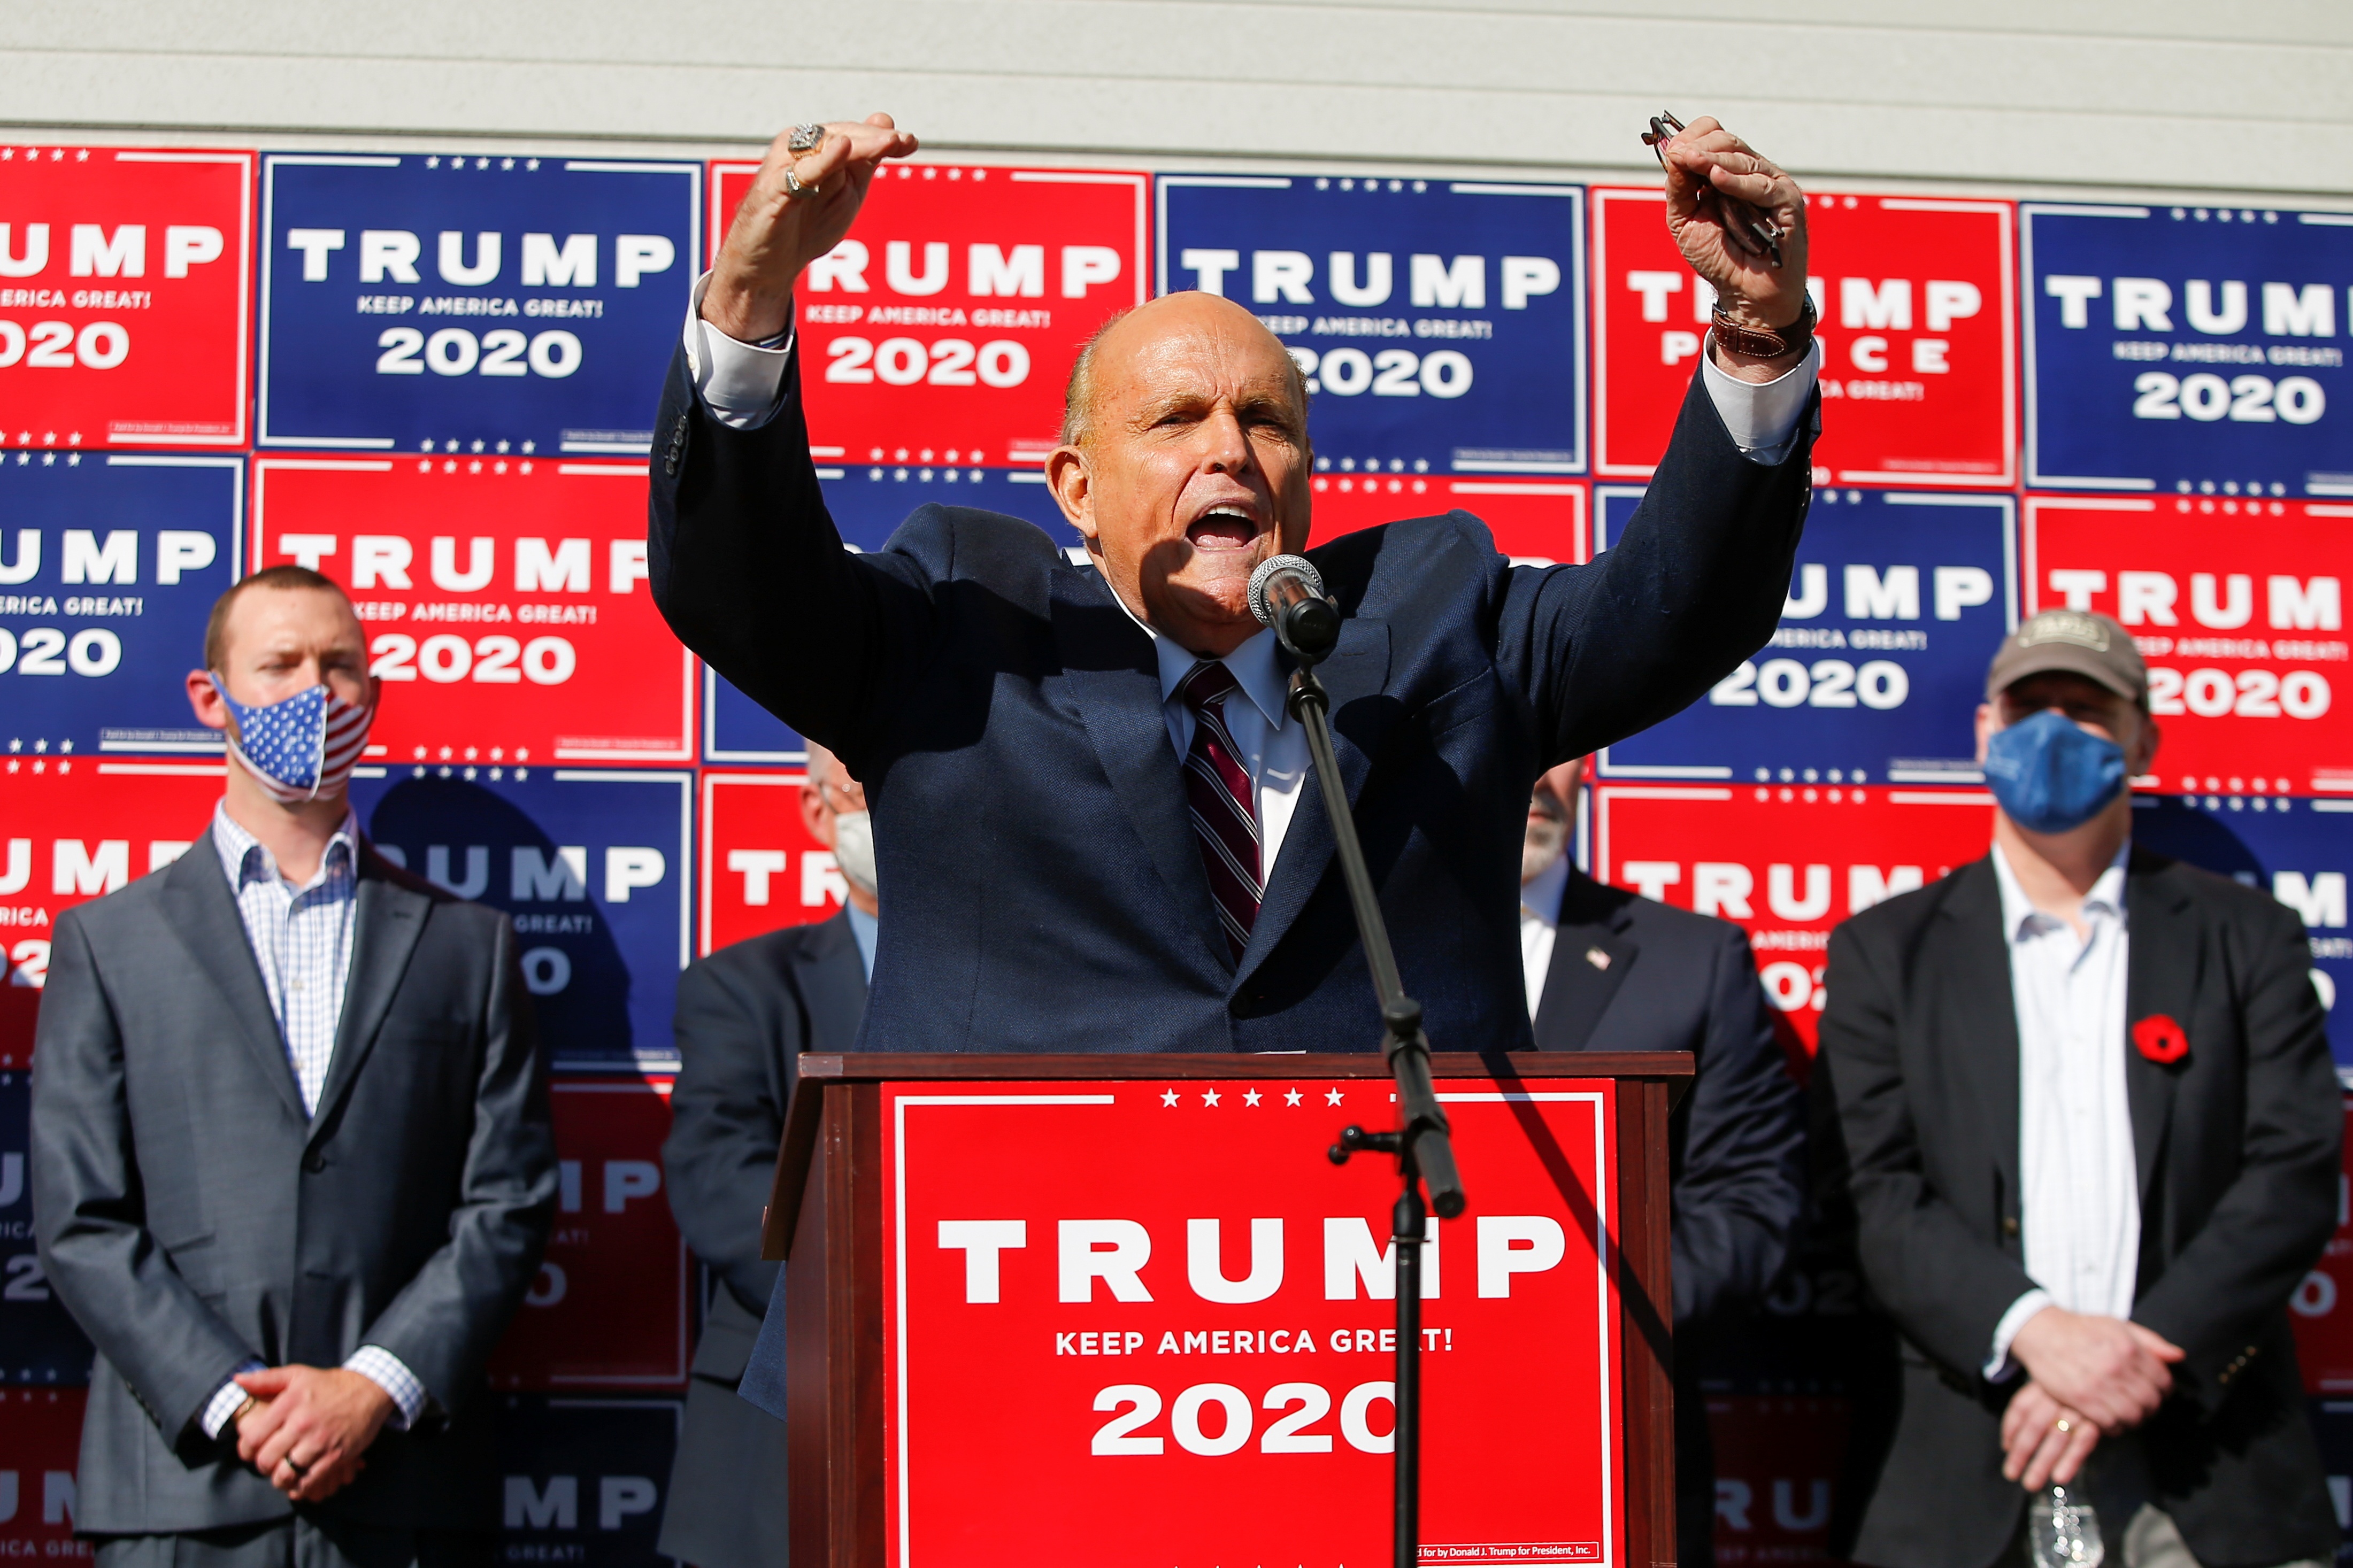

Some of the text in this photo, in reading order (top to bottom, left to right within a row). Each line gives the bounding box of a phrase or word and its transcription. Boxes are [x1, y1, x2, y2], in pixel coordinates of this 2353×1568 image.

[0, 222, 224, 278] UMP
[288, 229, 674, 287] TRUMP
[808, 240, 1121, 298] RUMP
[72, 290, 150, 308] GREAT!
[1181, 249, 1560, 310] TRUMP
[1627, 271, 1981, 331] TMP
[357, 296, 603, 317] KEEP AMERICA GREAT!
[806, 305, 1050, 327] KEEP AMERICA GREAT!
[1312, 318, 1410, 336] AMERICA
[1414, 319, 1492, 337] GREAT!
[2046, 275, 2353, 336] TRUM
[376, 328, 581, 377] 2020
[826, 337, 1030, 388] 2020
[1662, 331, 1951, 374] PCE
[2114, 342, 2342, 366] KEEP AMERICA GREAT!
[2135, 373, 2325, 423] 2020
[279, 534, 649, 593] TRUMP
[64, 597, 142, 615] GREAT!
[353, 602, 596, 623] KEEP AMERICA GREAT!
[1781, 565, 1993, 620] UMP
[369, 634, 575, 684] 2020
[1765, 628, 1927, 649] MERICA GREAT!
[2132, 636, 2173, 656] EEP
[2176, 638, 2270, 659] AMERICA
[1710, 659, 1909, 709] 2020
[2147, 668, 2331, 719] 2020
[377, 844, 665, 903] UMP
[1623, 861, 1952, 921] TRUM
[938, 1216, 1565, 1303] TRUMP
[1057, 1328, 1451, 1355] KEEP AMERICA GRET!
[1091, 1381, 1395, 1456] 2020
[1424, 1548, 1436, 1557] for
[1437, 1548, 1448, 1558] by
[1450, 1547, 1479, 1556] Donald
[1481, 1548, 1487, 1556] J.
[1488, 1547, 1516, 1557] Trump
[1518, 1546, 1530, 1555] for
[1532, 1546, 1573, 1555] President,
